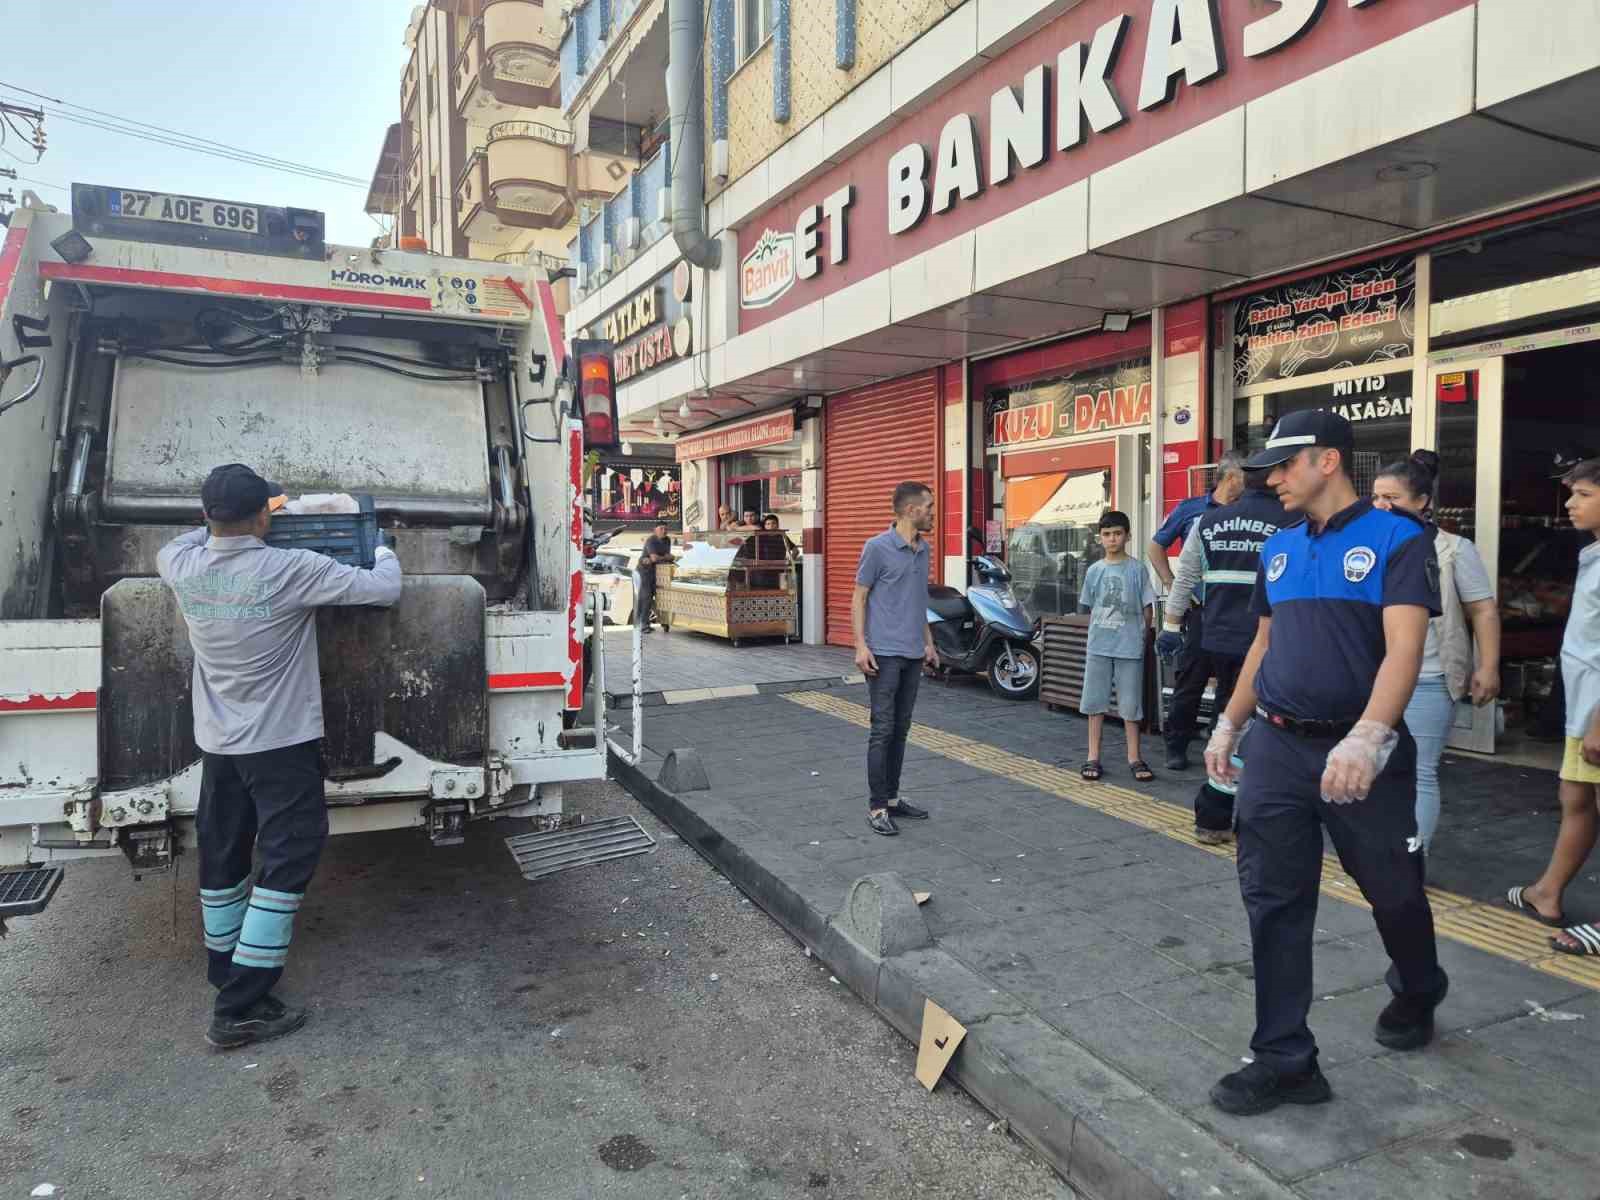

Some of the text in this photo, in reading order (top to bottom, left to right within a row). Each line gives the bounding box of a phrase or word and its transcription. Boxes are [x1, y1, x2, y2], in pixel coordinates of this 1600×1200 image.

[122, 193, 151, 216] 27
[213, 205, 256, 230] 696
[796, 184, 853, 281] ET
[744, 249, 790, 297] Banvit
[1249, 278, 1396, 325] Batıla Yardım Eden
[640, 324, 672, 370] USTA
[1248, 330, 1295, 350] Hakka
[1296, 320, 1337, 341] Zulm
[994, 401, 1054, 446] KUZU
[1074, 382, 1152, 434] DANA
[1202, 516, 1281, 541] ŞAHİNBE
